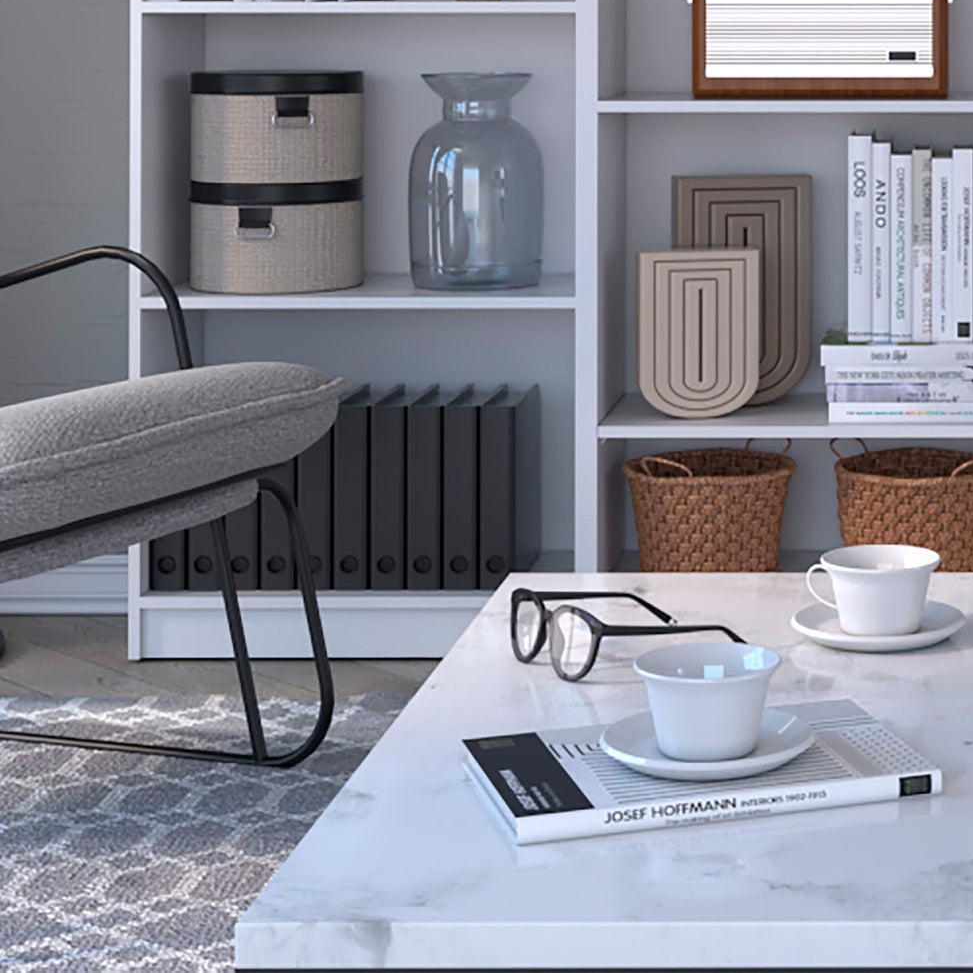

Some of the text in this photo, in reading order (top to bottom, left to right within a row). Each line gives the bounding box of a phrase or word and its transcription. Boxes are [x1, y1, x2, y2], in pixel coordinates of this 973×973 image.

[853, 161, 866, 198] LOOS
[875, 178, 886, 228] ANDO
[604, 807, 647, 824] JOSEF
[651, 798, 737, 818] HOFFMANN
[741, 795, 784, 808] INTERIORS
